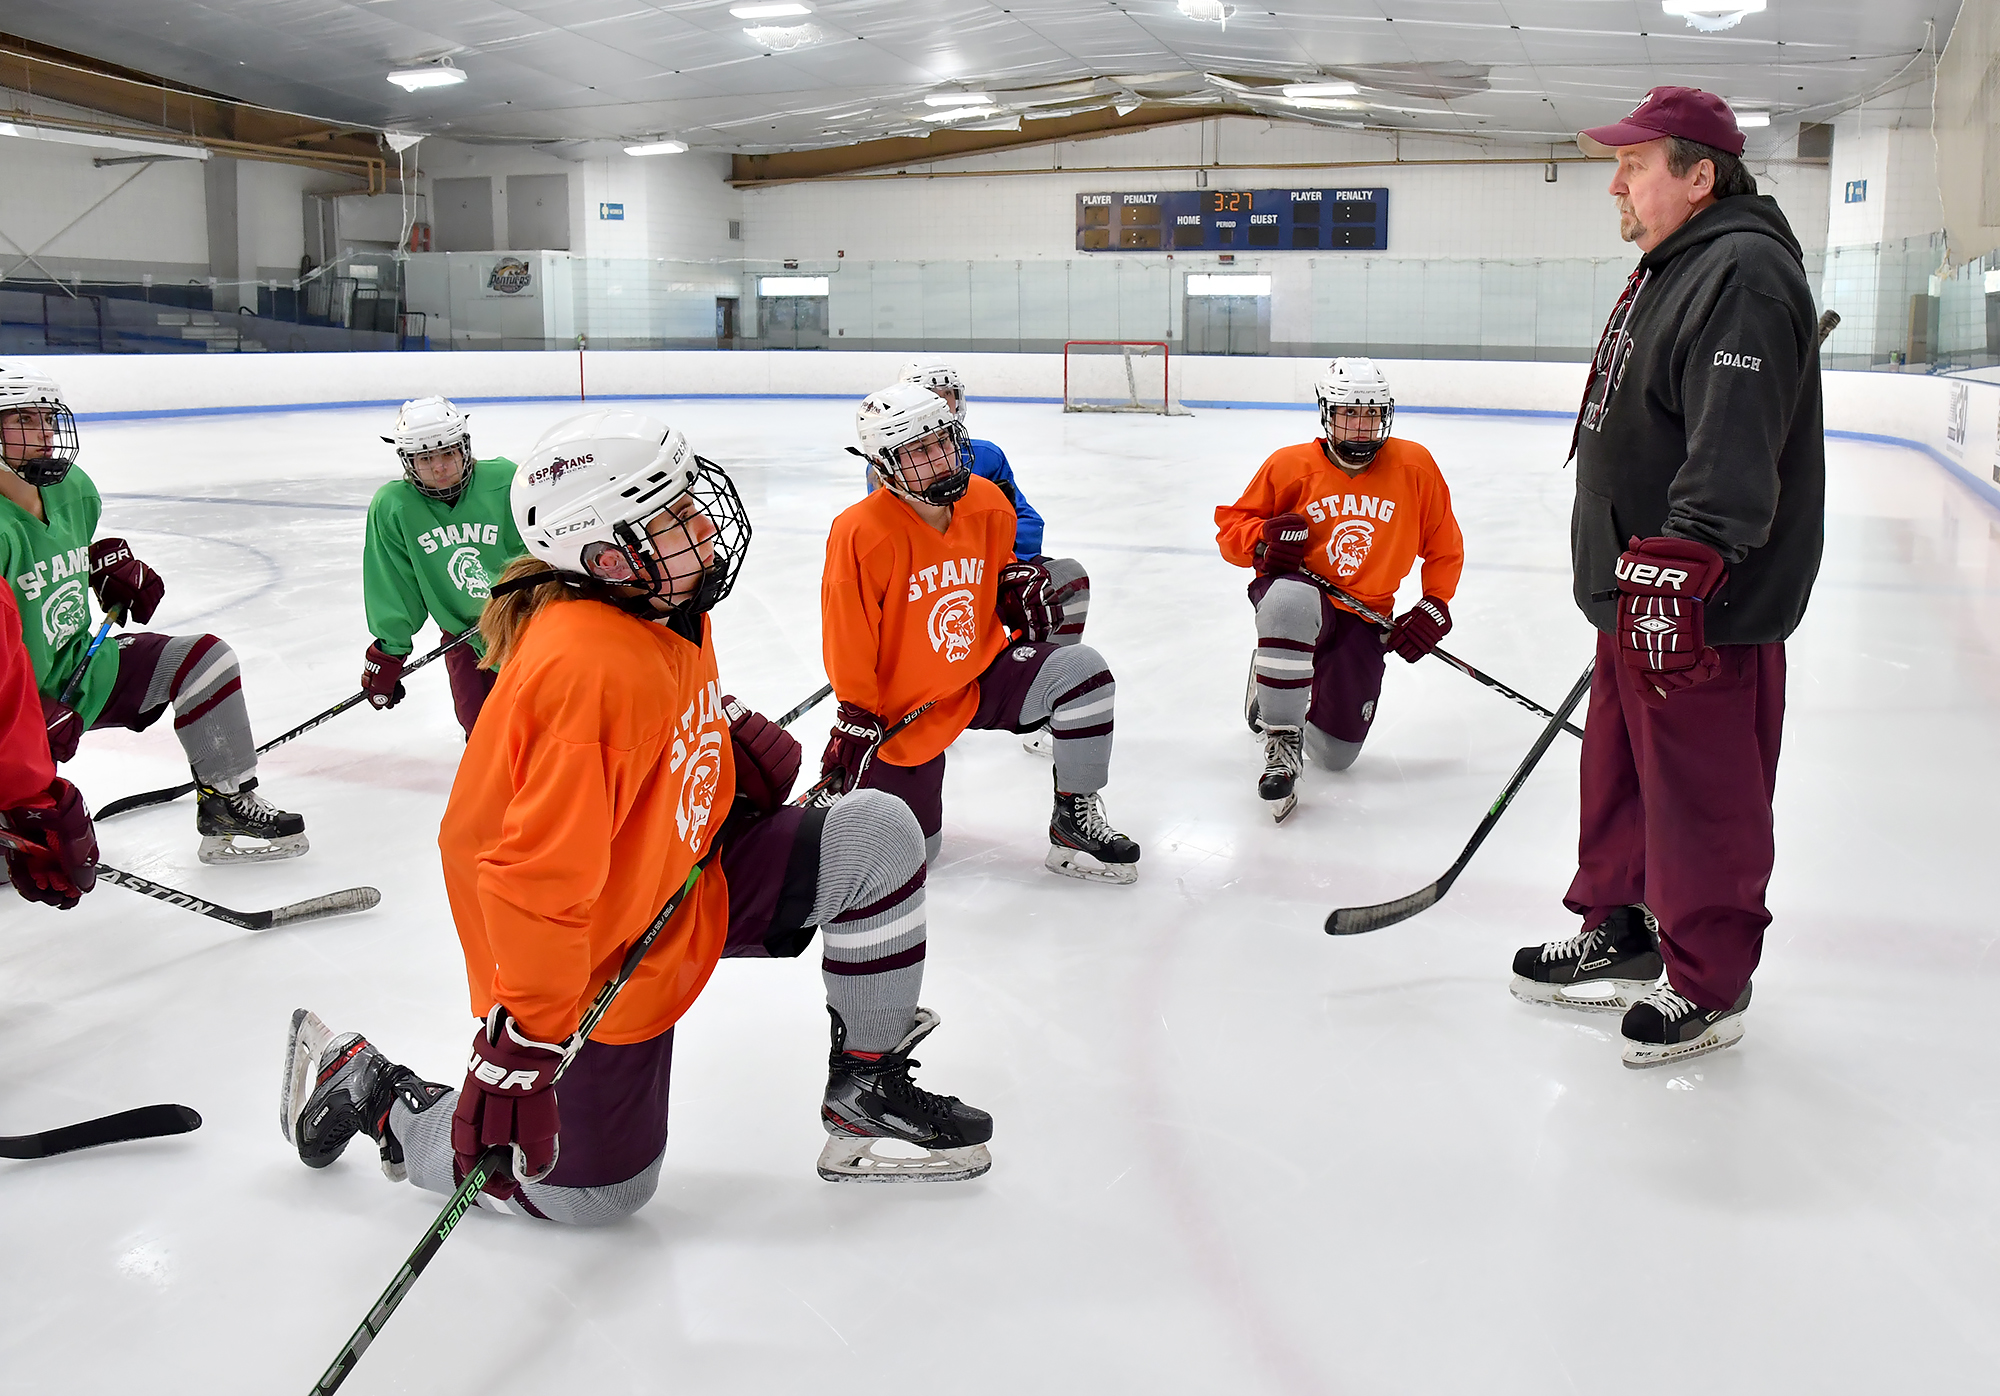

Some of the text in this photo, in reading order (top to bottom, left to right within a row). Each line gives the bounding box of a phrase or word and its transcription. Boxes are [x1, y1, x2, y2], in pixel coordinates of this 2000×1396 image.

[1082, 194, 1157, 205] PLAYER PENALTY
[1214, 192, 1252, 212] 3:27
[1291, 191, 1373, 201] PLAYER PENALTY
[1177, 215, 1201, 225] HOME
[1215, 220, 1237, 228] PERIOD
[1250, 214, 1278, 224] GUEST
[1713, 350, 1762, 372] COACH
[535, 453, 594, 480] SPATANS
[1306, 493, 1396, 524] STANG
[555, 518, 596, 537] CCM
[418, 523, 499, 555] STANG
[16, 546, 90, 601] STANG
[643, 928, 658, 946] FLEX
[1583, 959, 1609, 970] BAUER
[437, 1170, 488, 1241] BAUER
